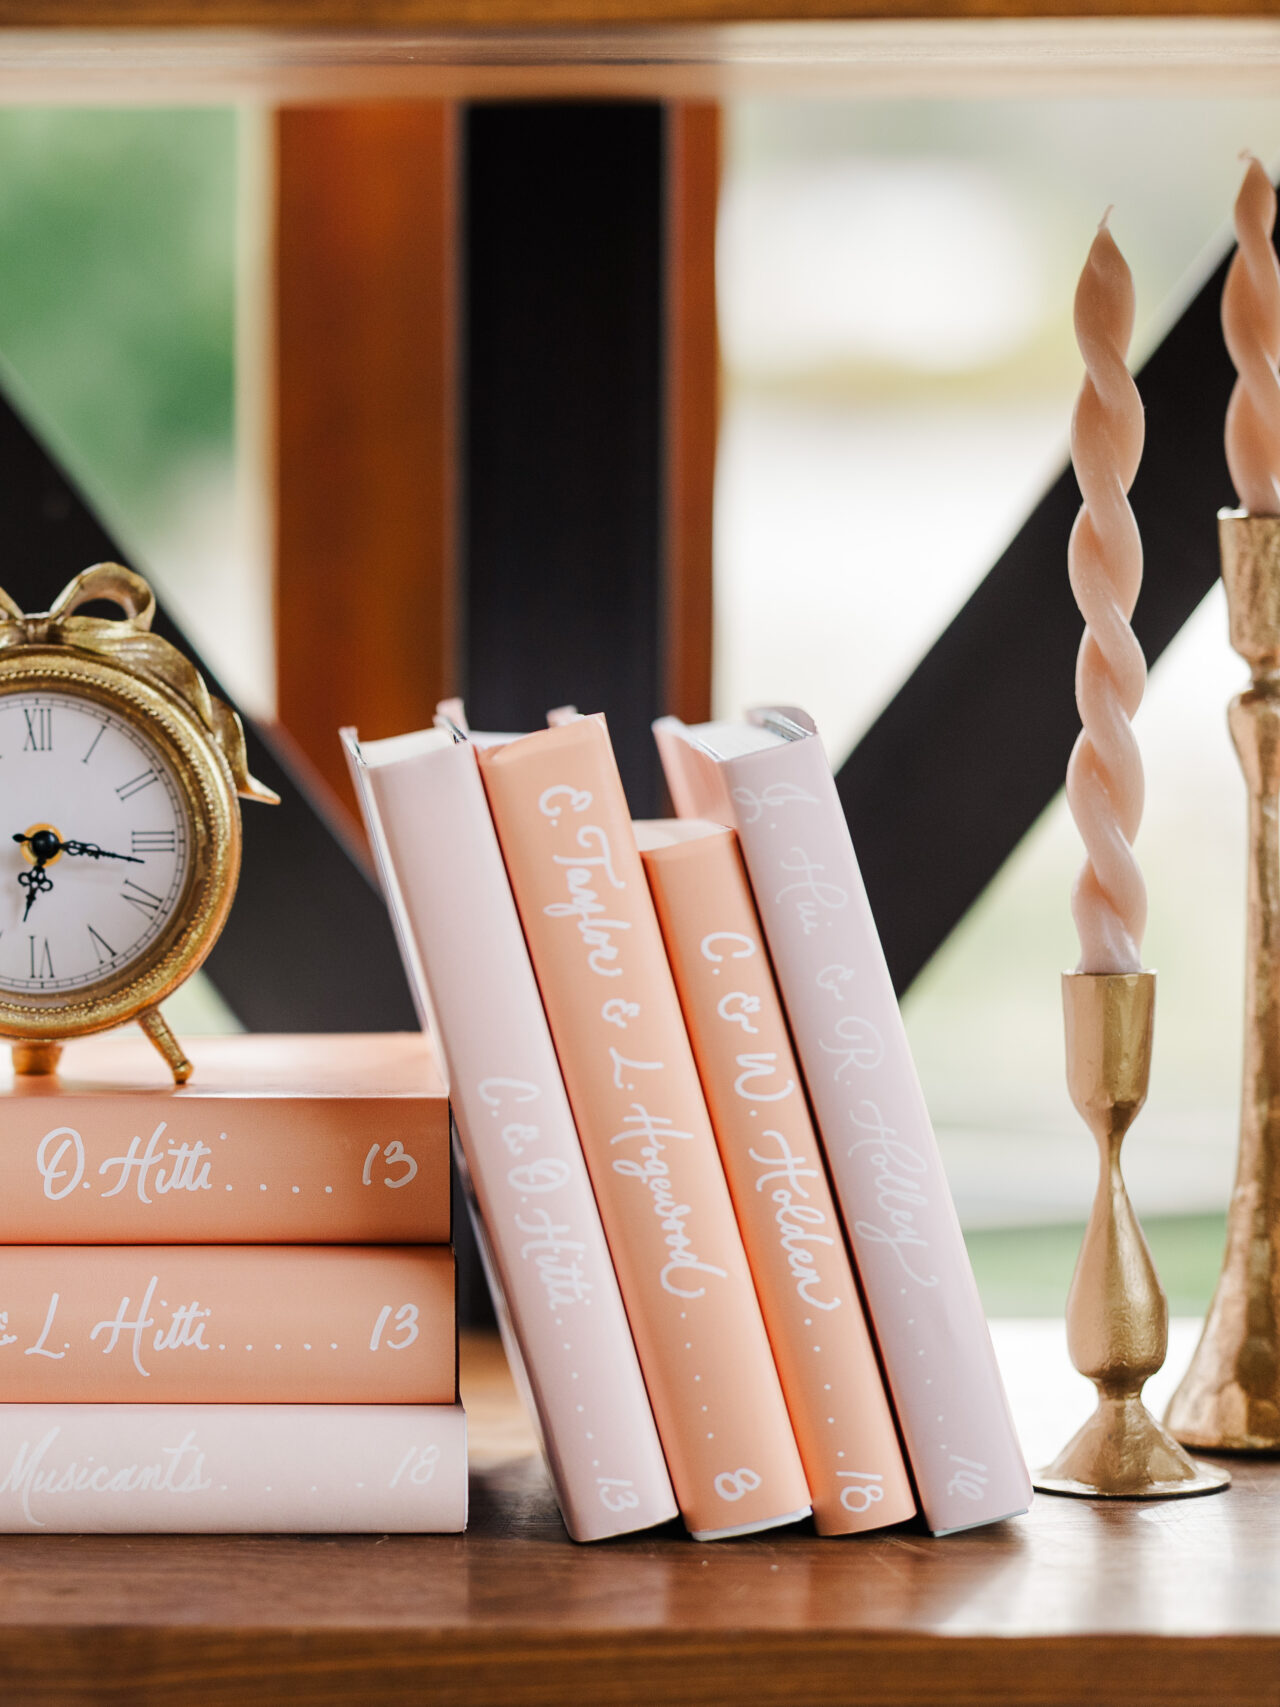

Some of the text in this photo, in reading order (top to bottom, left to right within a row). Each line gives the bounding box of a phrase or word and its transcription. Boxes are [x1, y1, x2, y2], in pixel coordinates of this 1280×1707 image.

[23, 708, 52, 752] XII
[115, 769, 159, 801] II
[131, 830, 175, 853] III
[542, 825, 632, 977] Taylor
[28, 935, 55, 979] VI
[87, 924, 117, 964] V
[601, 998, 640, 1029] &
[100, 1122, 228, 1204] Hitti
[362, 1140, 418, 1188] 13
[609, 1103, 728, 1298] Hogewood
[848, 1100, 939, 1287] Holley
[717, 991, 761, 1034] &
[747, 1129, 841, 1311] Holden
[836, 1470, 884, 1513] 18
[91, 1275, 211, 1377] Hitti
[370, 1306, 419, 1350] 13
[514, 1208, 593, 1310] Hitti
[596, 1477, 640, 1512] 13
[390, 1445, 440, 1487] 18
[714, 1467, 762, 1501] 8
